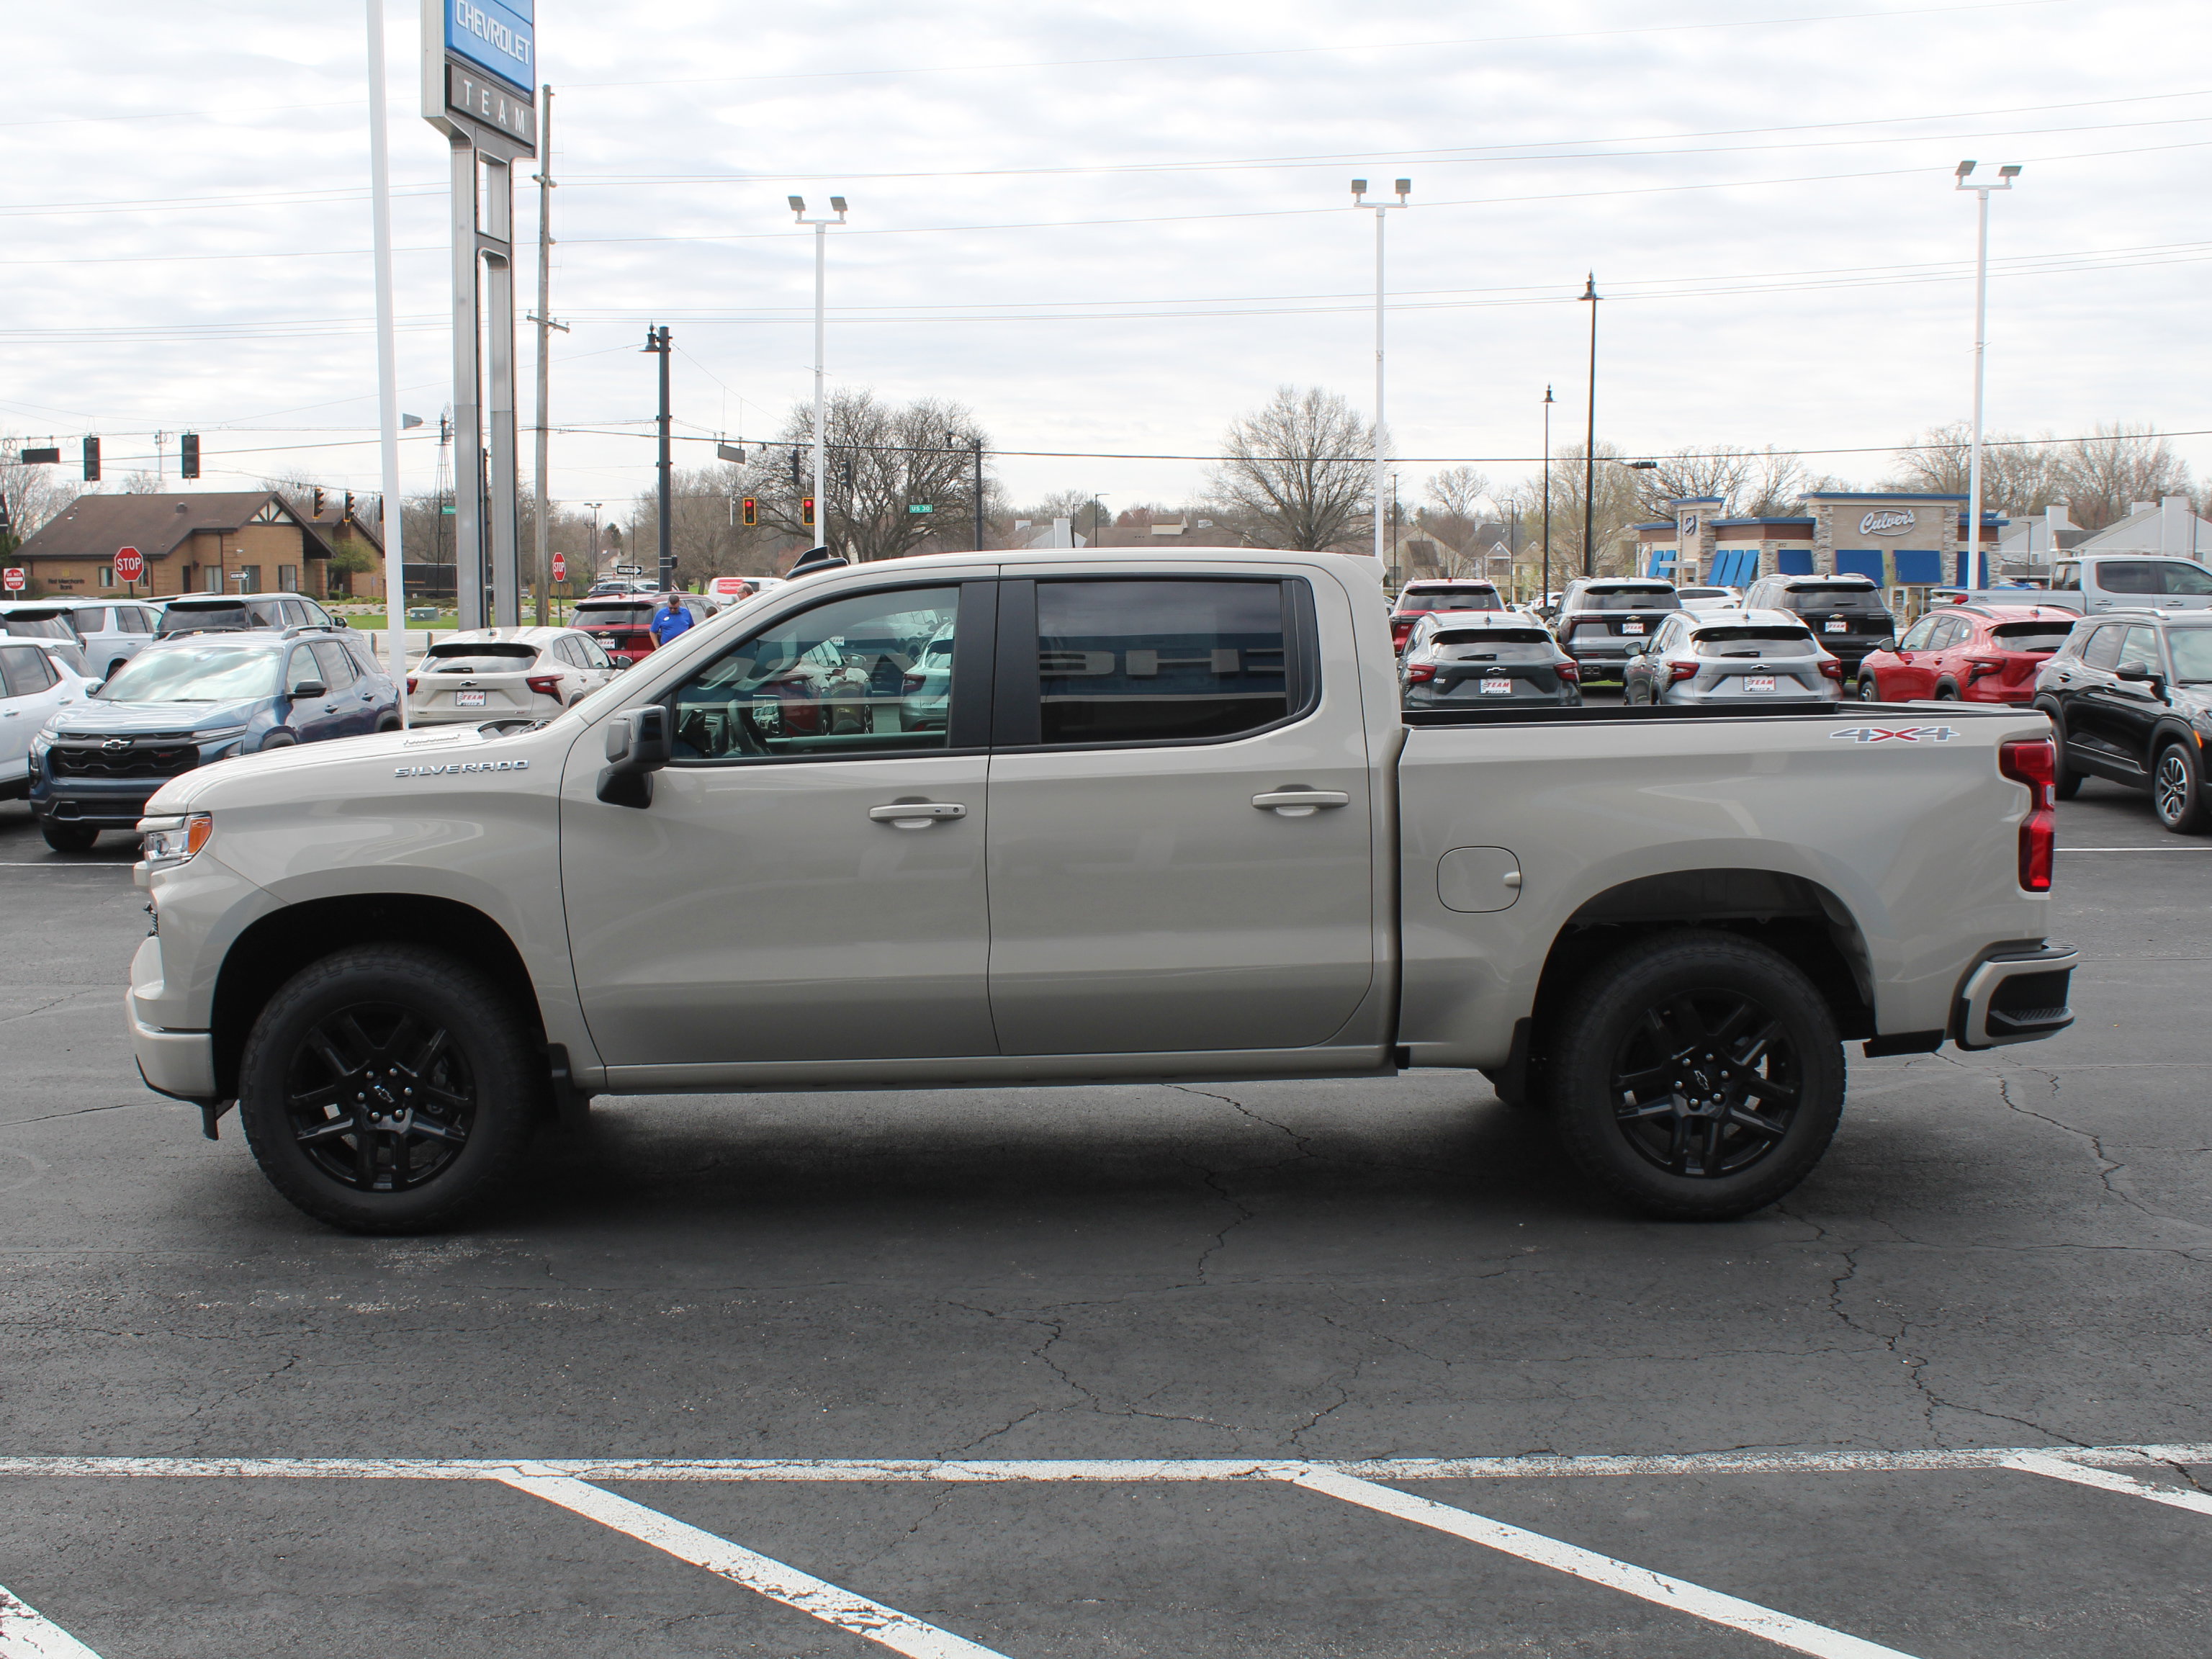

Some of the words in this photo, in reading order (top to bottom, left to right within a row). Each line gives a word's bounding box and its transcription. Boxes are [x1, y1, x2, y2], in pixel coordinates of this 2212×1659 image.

[456, 0, 531, 65] CHEVROLET
[463, 79, 525, 134] TEAM
[1859, 509, 1916, 534] Culver's
[117, 557, 141, 571] STOP
[554, 562, 565, 572] STOP
[395, 760, 529, 777] SILVERADO
